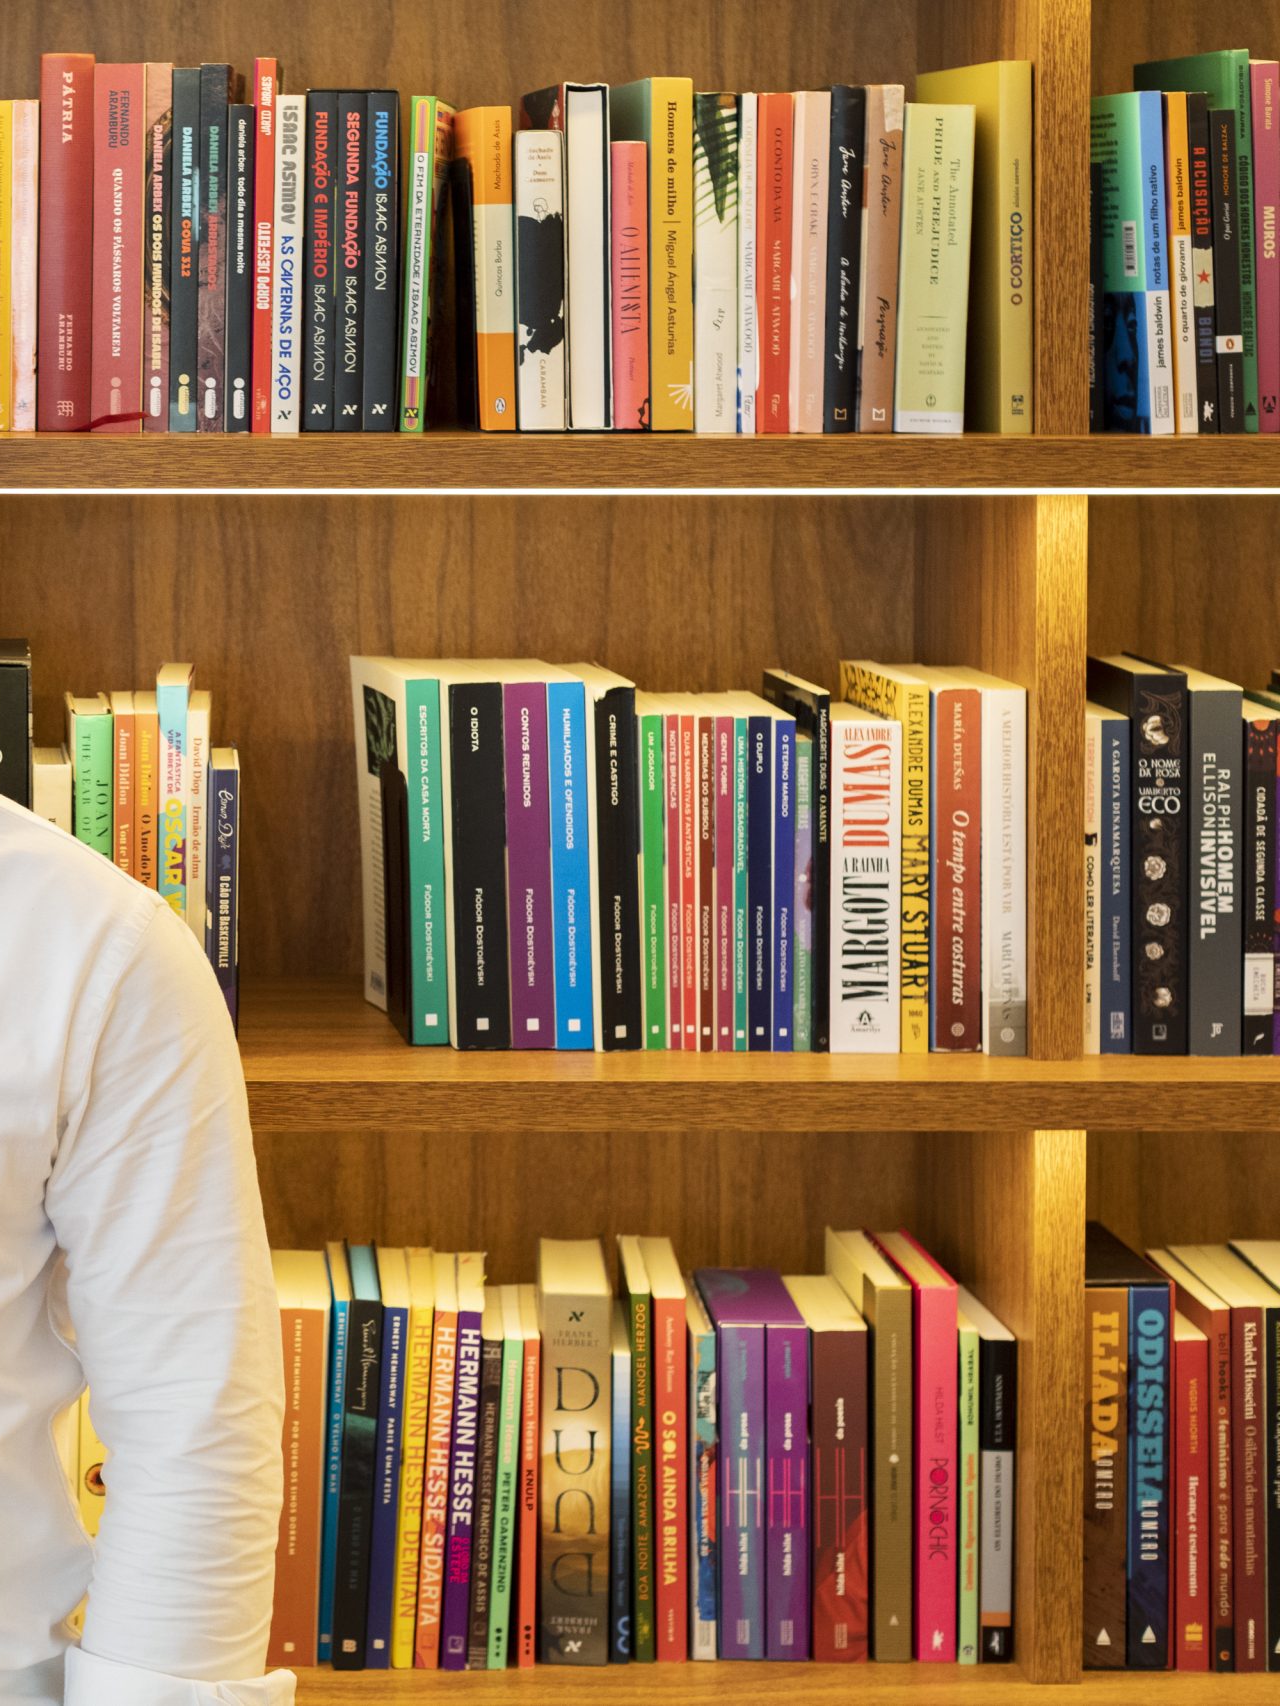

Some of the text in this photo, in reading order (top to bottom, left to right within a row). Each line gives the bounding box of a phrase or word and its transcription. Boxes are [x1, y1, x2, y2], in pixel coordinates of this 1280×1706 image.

[61, 72, 76, 143] PÁTRIA
[108, 90, 119, 148] ARAMBURU
[120, 90, 129, 146] FERNANDO
[370, 112, 390, 188] FUNDAÇÃO
[934, 118, 943, 166] PRIDE
[181, 127, 192, 276] DANIELA ARBEX COVA 312
[310, 112, 331, 277] FUNDAÇÃO E IMPÉRIO
[340, 112, 360, 268] SEGUNDA FUNDAÇÃO
[667, 102, 677, 215] Homens de milho
[947, 159, 960, 246] The Annotated
[1192, 161, 1209, 235] ACUSAÇÃO
[112, 169, 125, 356] QUANDO OS PÁSSAROS VOLTAREM
[258, 222, 271, 309] CORPO DESFEITO
[375, 194, 387, 290] ISAAC ASIMOV
[930, 196, 940, 285] PREJUDICE
[1010, 212, 1025, 305] O CORTIÇO
[1149, 165, 1161, 284] notas de um filho nativo
[1264, 206, 1275, 258] MUROS
[275, 236, 294, 400] AS CAVERNAS DE AÇO
[1154, 296, 1167, 368] james baldwin
[520, 708, 531, 807] CONTOS REUNIDOS
[609, 715, 617, 747] CRIME
[610, 760, 619, 805] CASTIGO
[843, 743, 890, 848] DUMAS
[1138, 795, 1181, 814] ECO
[164, 799, 183, 886] OSCAR
[1200, 753, 1219, 939] ELLISON INVISÍVEL
[1217, 769, 1233, 913] RALPH HOMEM
[842, 876, 889, 1002] MARGOT
[902, 835, 929, 1004] MARY STUART
[946, 810, 969, 1005] O tempo entre costuras
[456, 1328, 480, 1445] HERMANN
[1092, 1311, 1126, 1461] ILÍADA
[1137, 1309, 1163, 1510] ODISSEIA
[1244, 1322, 1256, 1419] Khaled Hosseini
[420, 1327, 454, 1626] HERMANN HESSE SIDARTA
[663, 1411, 676, 1585] O SOL AINDA BRILHA
[497, 1473, 511, 1593] PETER CAMENZIND
[1141, 1500, 1158, 1560] HOMERO
